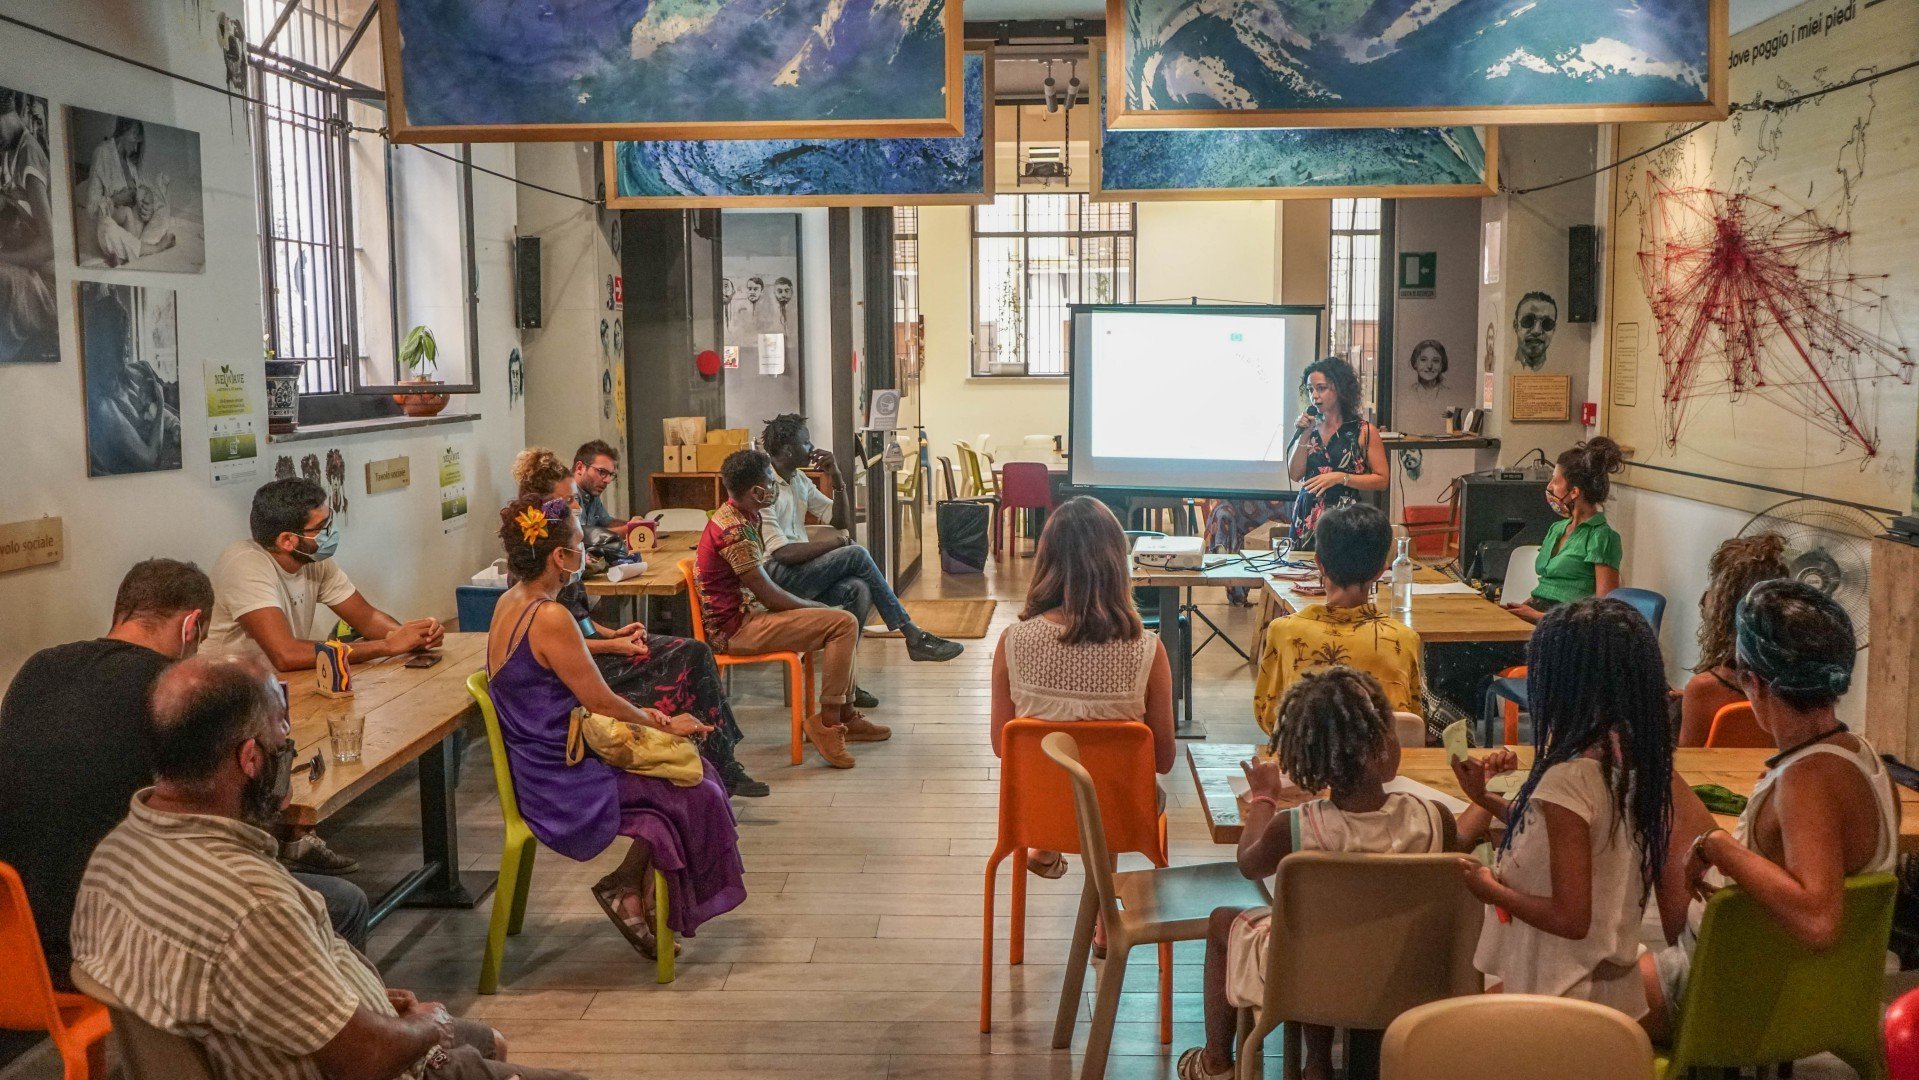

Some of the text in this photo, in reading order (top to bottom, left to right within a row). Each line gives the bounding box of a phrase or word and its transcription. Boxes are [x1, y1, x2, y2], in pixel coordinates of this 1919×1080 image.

[1751, 30, 1789, 65] poggio
[1791, 24, 1796, 44] i
[1797, 12, 1822, 42] miei
[1824, 0, 1857, 36] piedi
[22, 534, 54, 551] sociale
[638, 533, 645, 543] 8
[322, 664, 326, 678] 6
